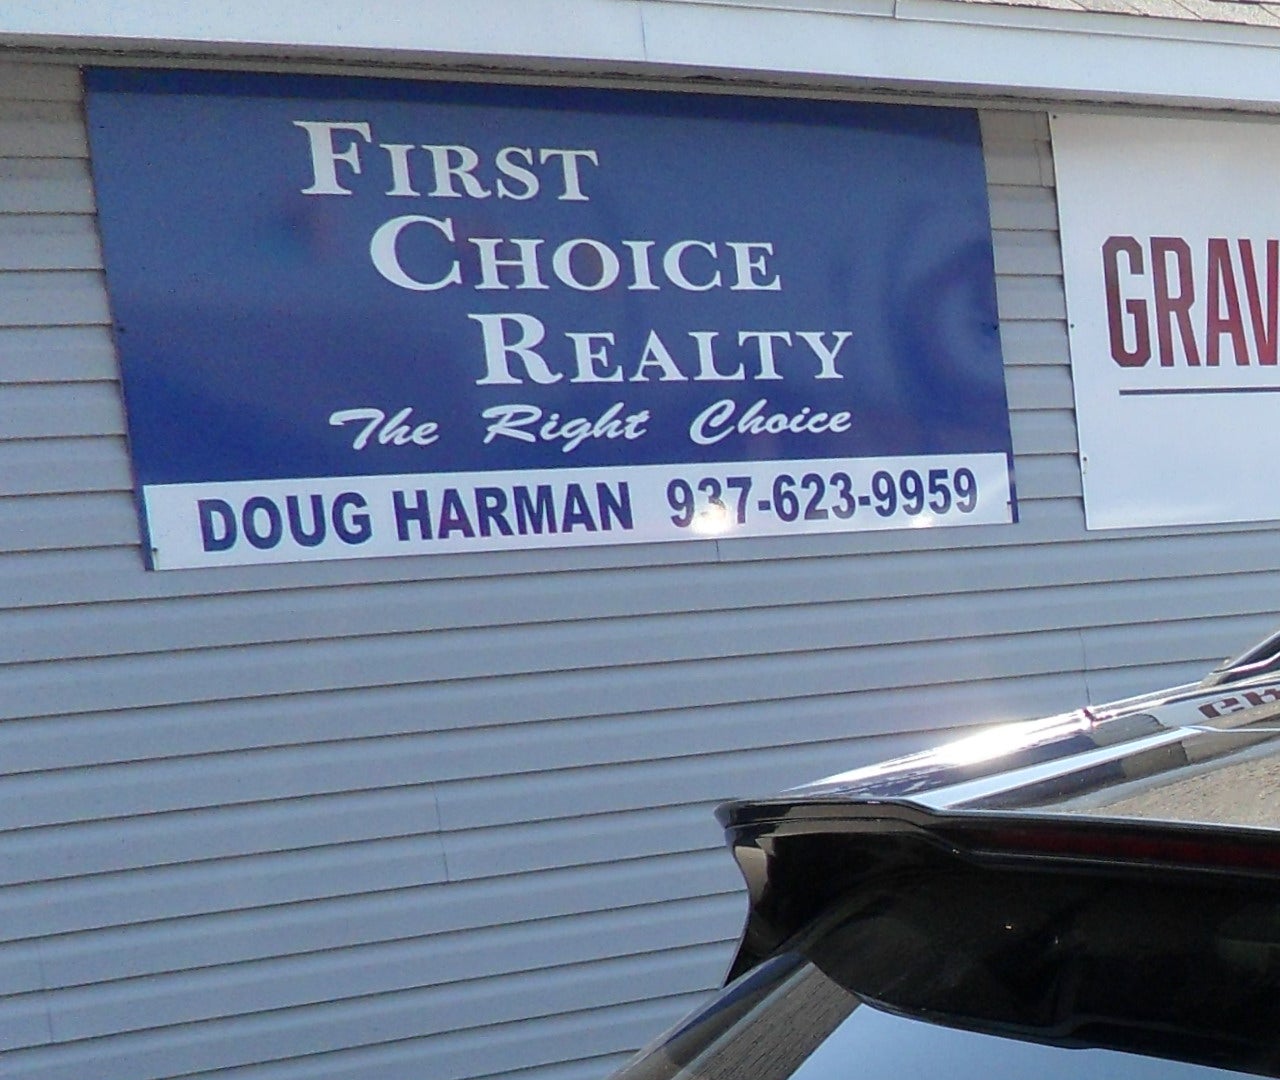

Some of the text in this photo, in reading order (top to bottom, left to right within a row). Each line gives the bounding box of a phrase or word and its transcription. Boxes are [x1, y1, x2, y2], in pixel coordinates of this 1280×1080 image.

[293, 120, 599, 200] FIRST
[369, 214, 782, 291] CHOICE
[467, 312, 853, 385] REALTY
[329, 398, 852, 453] The Right Choice
[197, 467, 978, 552] DOUG HARMAN 937-623-9959
